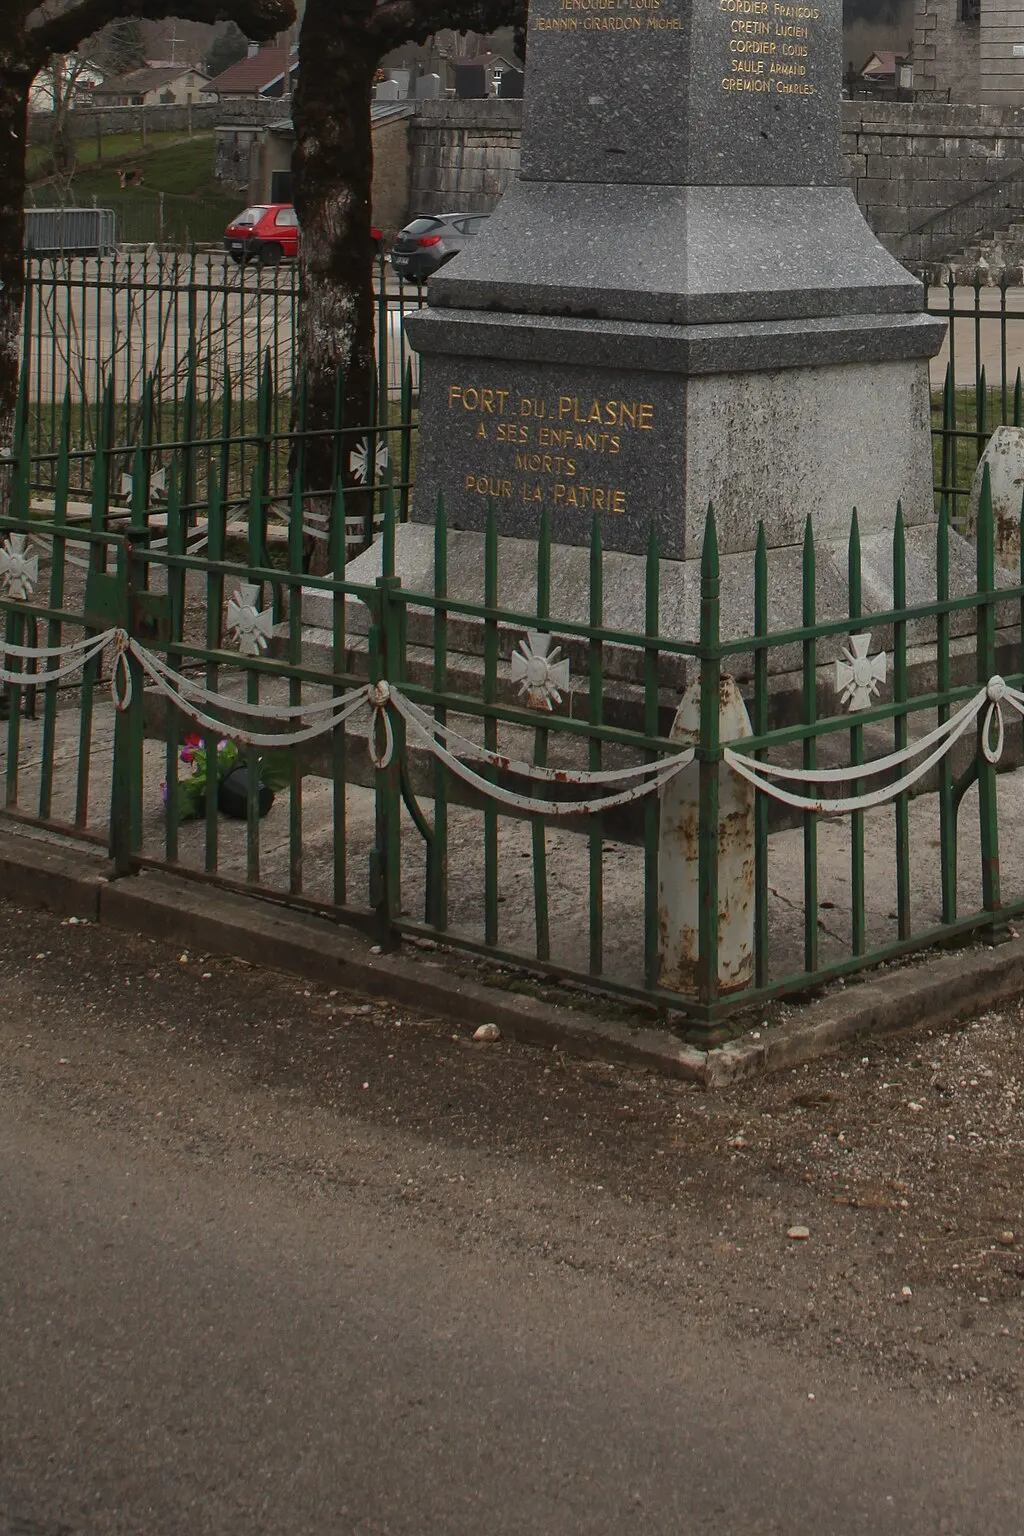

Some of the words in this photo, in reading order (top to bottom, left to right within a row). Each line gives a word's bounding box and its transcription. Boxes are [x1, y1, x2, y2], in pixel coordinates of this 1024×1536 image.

[647, 17, 684, 30] MICHEL
[730, 20, 770, 35] CRETIN
[775, 26, 808, 39] LUCIEN
[729, 39, 776, 54] CORDIER
[782, 44, 808, 57] LOUIS
[731, 59, 764, 74] SAULE
[769, 63, 806, 76] ARMAND
[721, 78, 770, 93] GREMION
[775, 81, 816, 95] CHARLES
[496, 423, 528, 443] SES
[537, 426, 620, 453] ENFANTS
[514, 450, 577, 476] MORTS
[464, 473, 512, 498] POUR
[522, 481, 543, 502] LA
[553, 483, 626, 513] PATRIE
